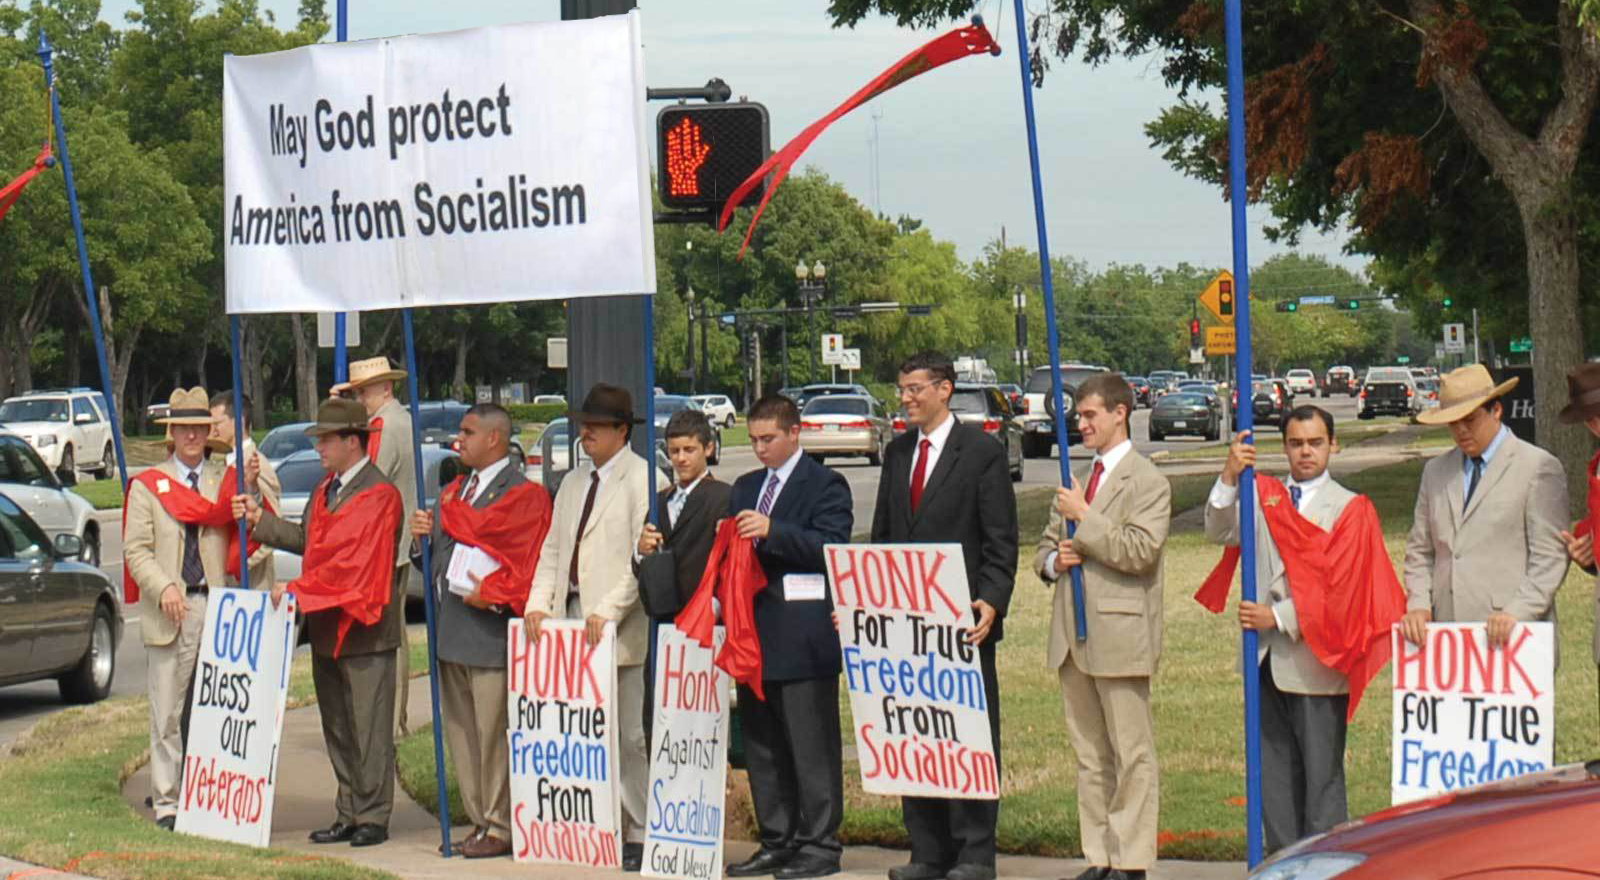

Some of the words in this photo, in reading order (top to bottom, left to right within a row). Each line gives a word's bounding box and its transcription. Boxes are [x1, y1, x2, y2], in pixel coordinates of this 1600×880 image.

[270, 103, 308, 168] May
[315, 95, 375, 153] God
[388, 83, 512, 160] protect
[230, 194, 325, 247] America
[331, 189, 406, 242] from
[414, 174, 587, 237] Socialism
[828, 547, 962, 620] HONK
[214, 592, 268, 672] God
[510, 625, 605, 704] HONK
[906, 614, 974, 664] True
[1394, 626, 1544, 700] HONK
[198, 662, 252, 714] Bless
[662, 644, 721, 714] Honk
[844, 647, 985, 711] Freedom
[220, 715, 256, 760] our
[554, 700, 606, 739] True
[1462, 697, 1540, 746] True
[657, 727, 719, 781] Against
[860, 723, 997, 795] Socialism
[184, 755, 266, 826] Veterans
[650, 779, 721, 839] Socialism
[513, 801, 619, 867] Socialism
[651, 843, 679, 875] God
